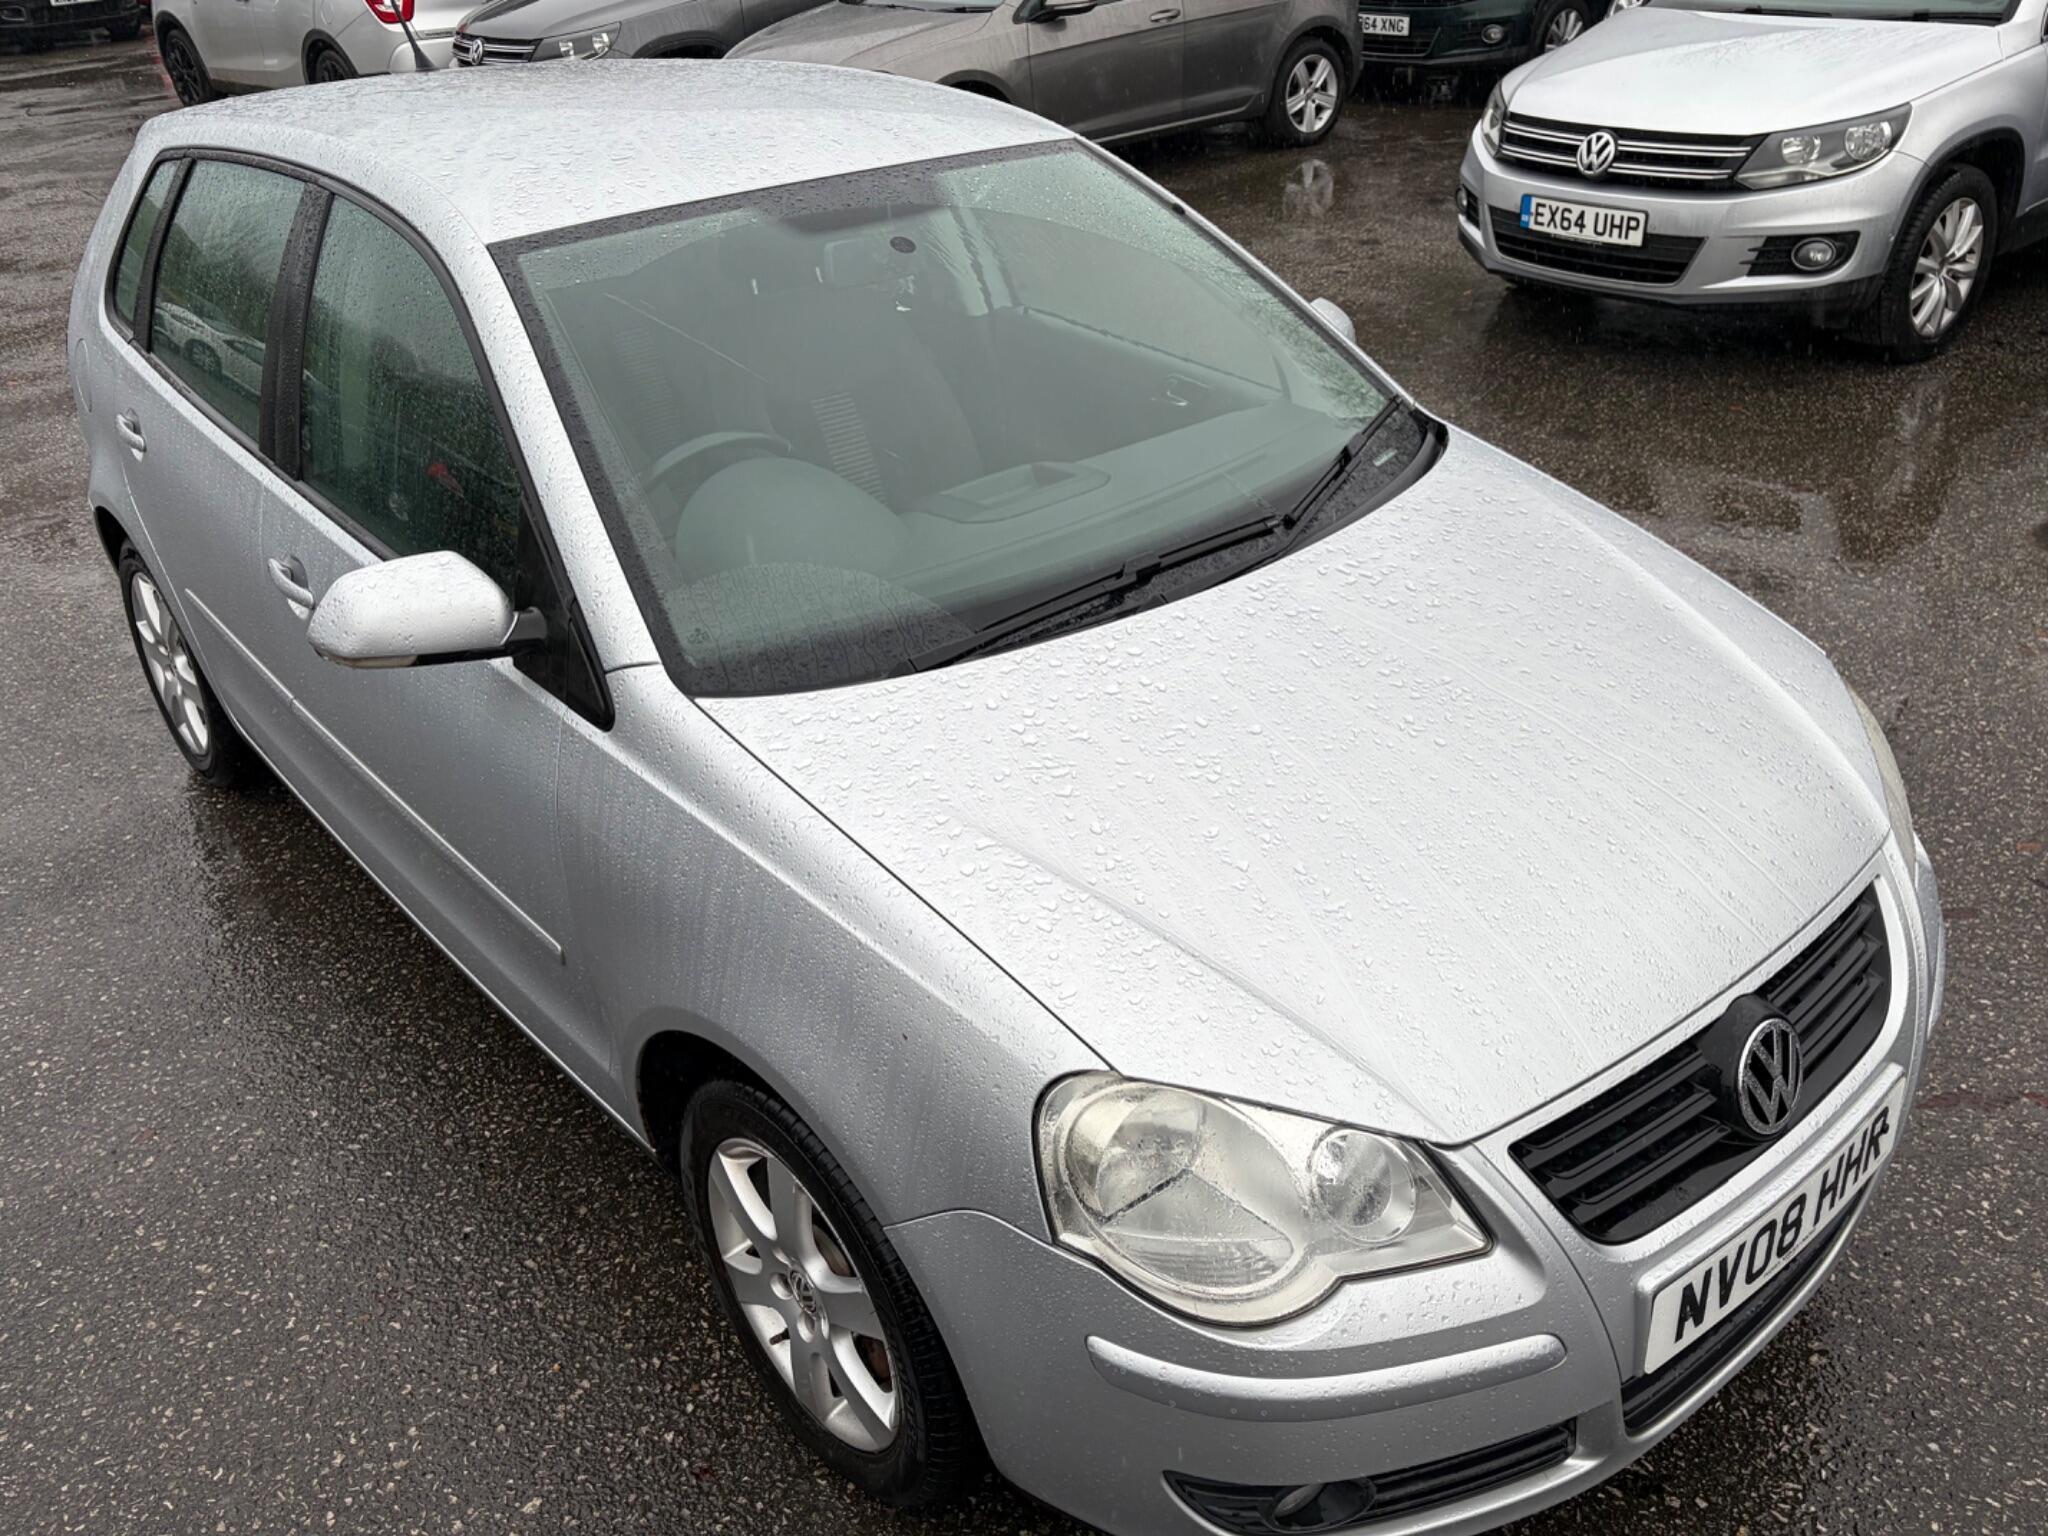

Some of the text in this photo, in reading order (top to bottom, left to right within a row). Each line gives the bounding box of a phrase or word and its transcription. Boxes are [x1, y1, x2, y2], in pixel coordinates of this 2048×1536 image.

[1380, 18, 1404, 33] XNG
[1534, 202, 1640, 240] EX64 UHP
[1674, 1106, 1889, 1343] NV08 HHR
